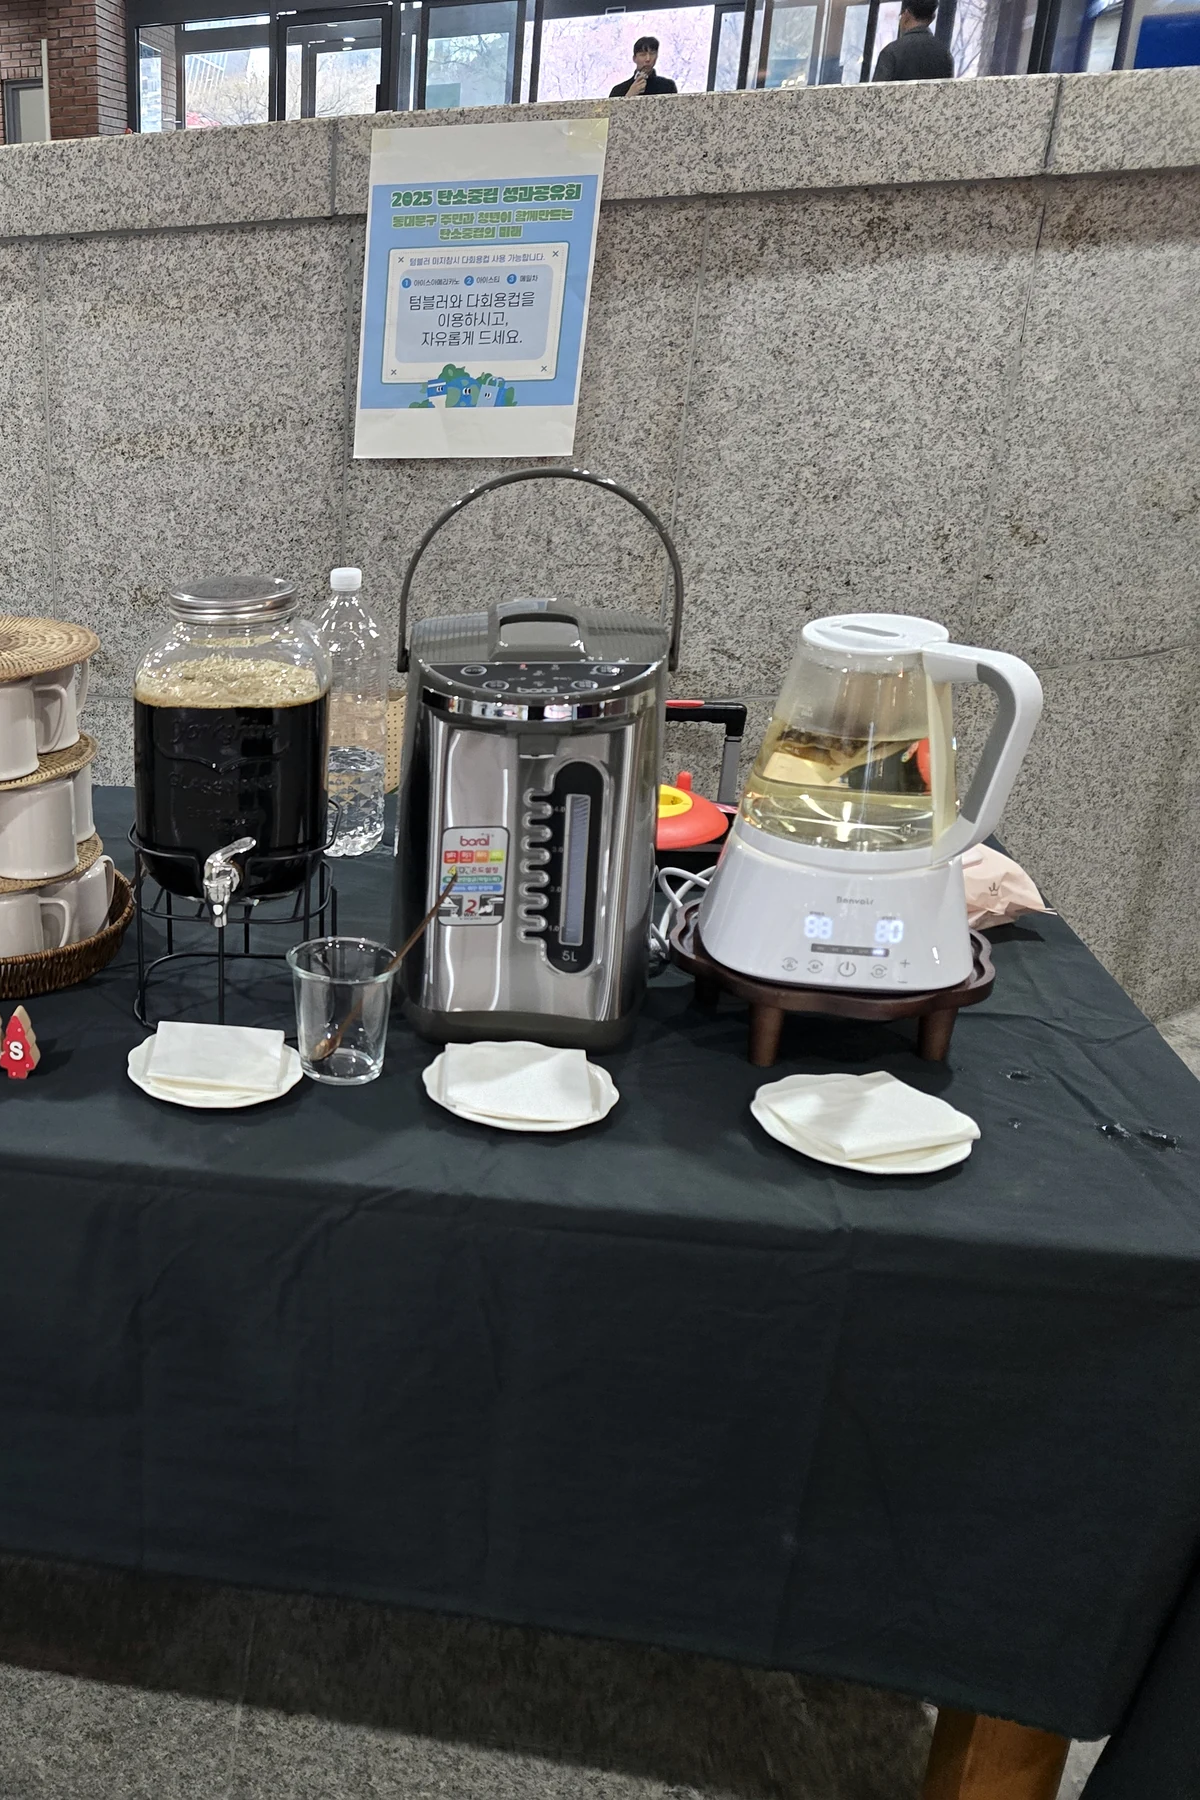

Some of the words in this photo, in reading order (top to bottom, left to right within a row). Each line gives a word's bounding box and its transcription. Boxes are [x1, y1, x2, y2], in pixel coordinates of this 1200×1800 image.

[391, 190, 433, 207] 2025
[437, 186, 499, 206] 탄소중립
[502, 183, 582, 203] 성과공유회
[392, 214, 437, 228] 동대문구
[440, 212, 475, 225] 주민과
[478, 210, 512, 224] 청년이
[515, 208, 573, 222] 함께만드는
[439, 226, 496, 240] 탄소중립의
[499, 225, 523, 238] 미래
[409, 257, 430, 267] 텀블러
[462, 254, 490, 264] 다회용컵
[491, 254, 506, 264] 사용
[508, 253, 546, 262] 가능합니다.
[413, 277, 460, 287] 아이스아메리카노
[476, 275, 500, 284] 아이스티
[409, 294, 463, 311] 텀블러와
[466, 291, 535, 308] 다회용컵을
[437, 311, 509, 328] 이용하시고,
[421, 331, 475, 347] 자유롭게
[478, 329, 523, 345] 드세요.
[517, 686, 558, 694] boral
[460, 834, 490, 846] boral
[465, 899, 477, 914] 2
[562, 951, 578, 962] 5L
